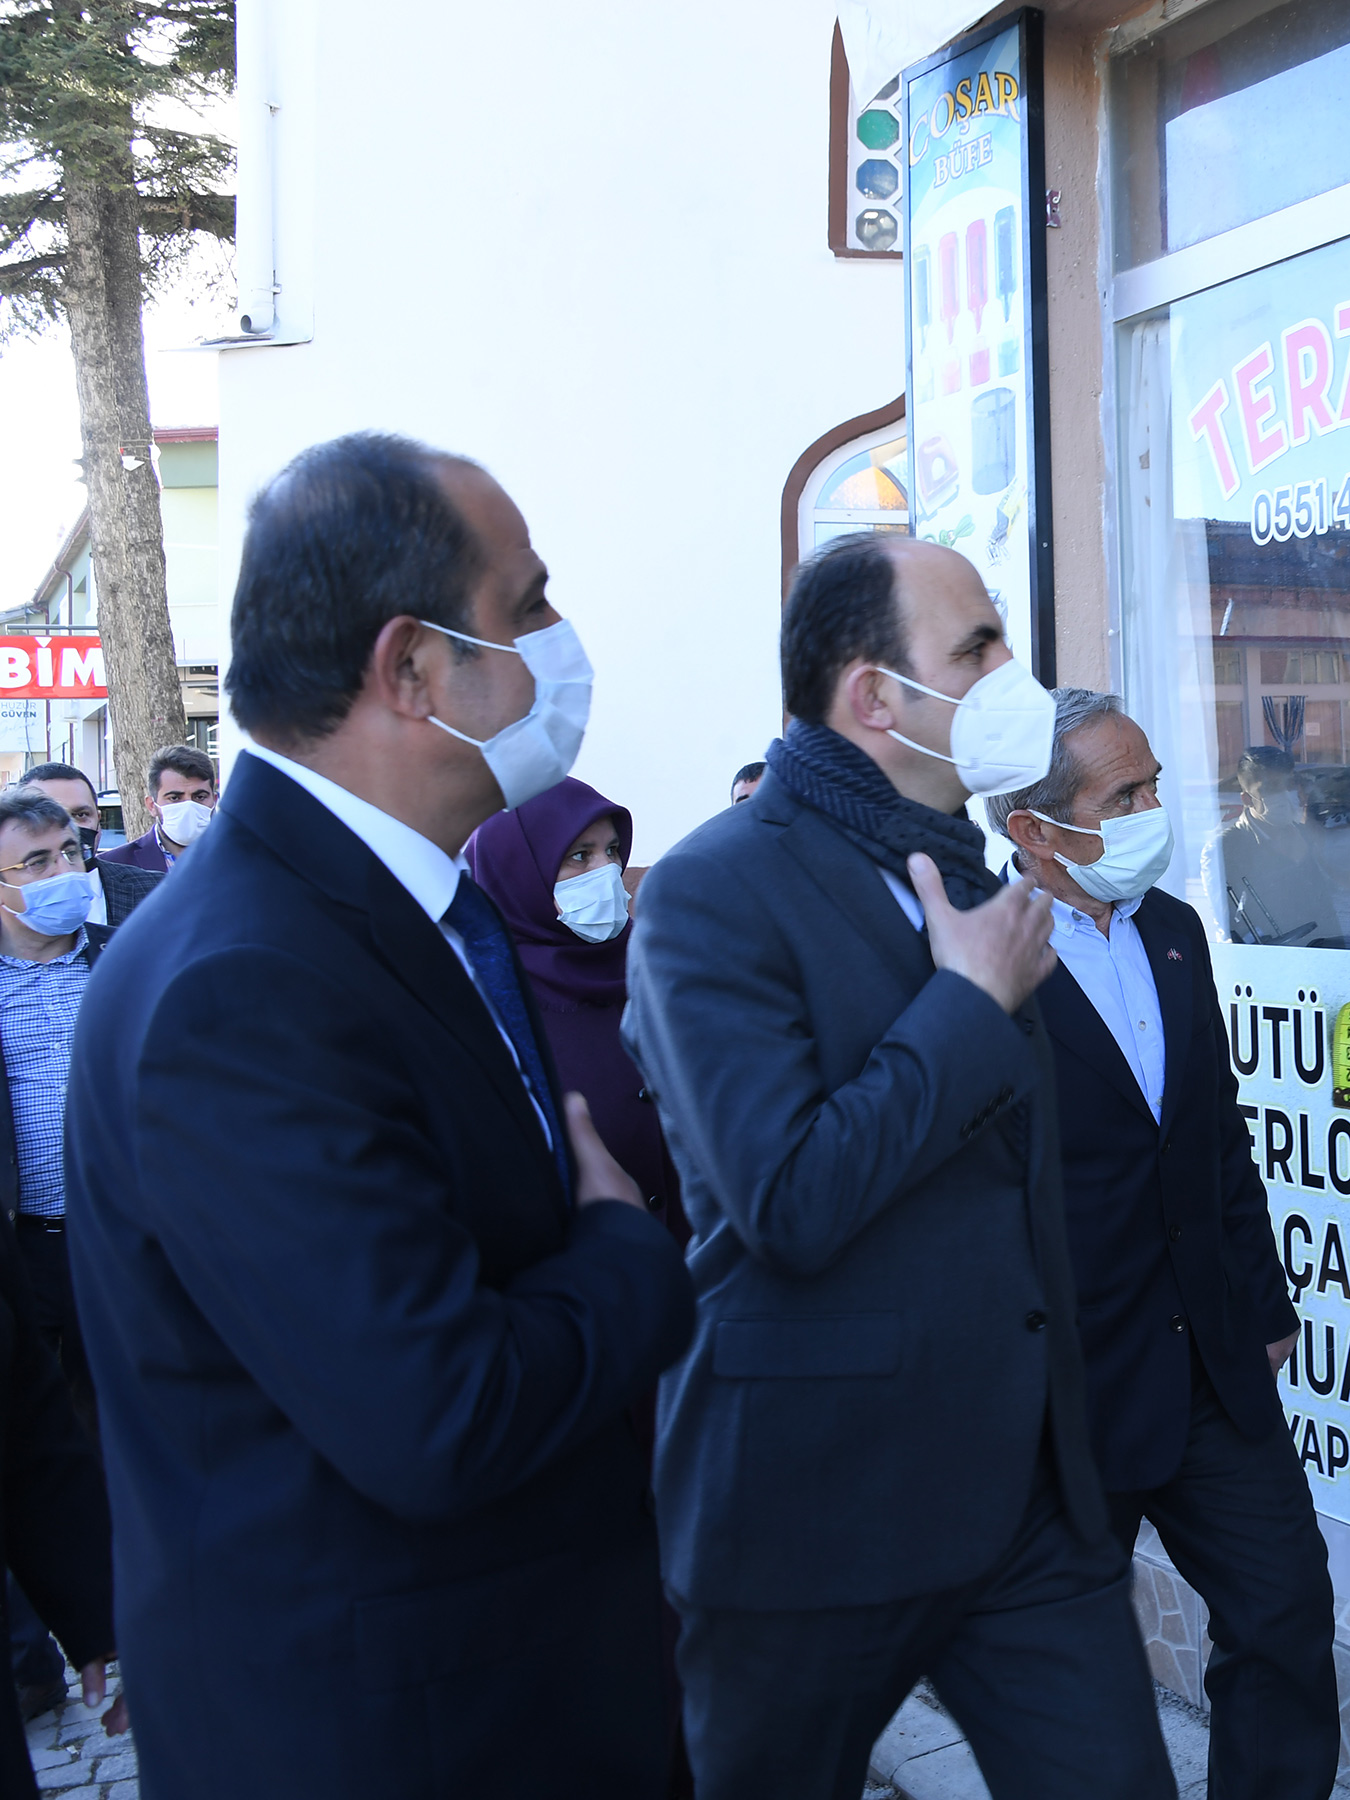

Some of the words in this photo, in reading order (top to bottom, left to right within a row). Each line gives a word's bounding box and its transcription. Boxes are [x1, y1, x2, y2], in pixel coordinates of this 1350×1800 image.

[909, 71, 1021, 168] COŞAR
[933, 131, 994, 189] BÜFE
[1252, 478, 1329, 545] 0551
[0, 636, 107, 688] BİM
[1, 702, 37, 710] HUZUR
[1, 709, 37, 718] GÜVEN
[1230, 984, 1325, 1085] ÜTÜ
